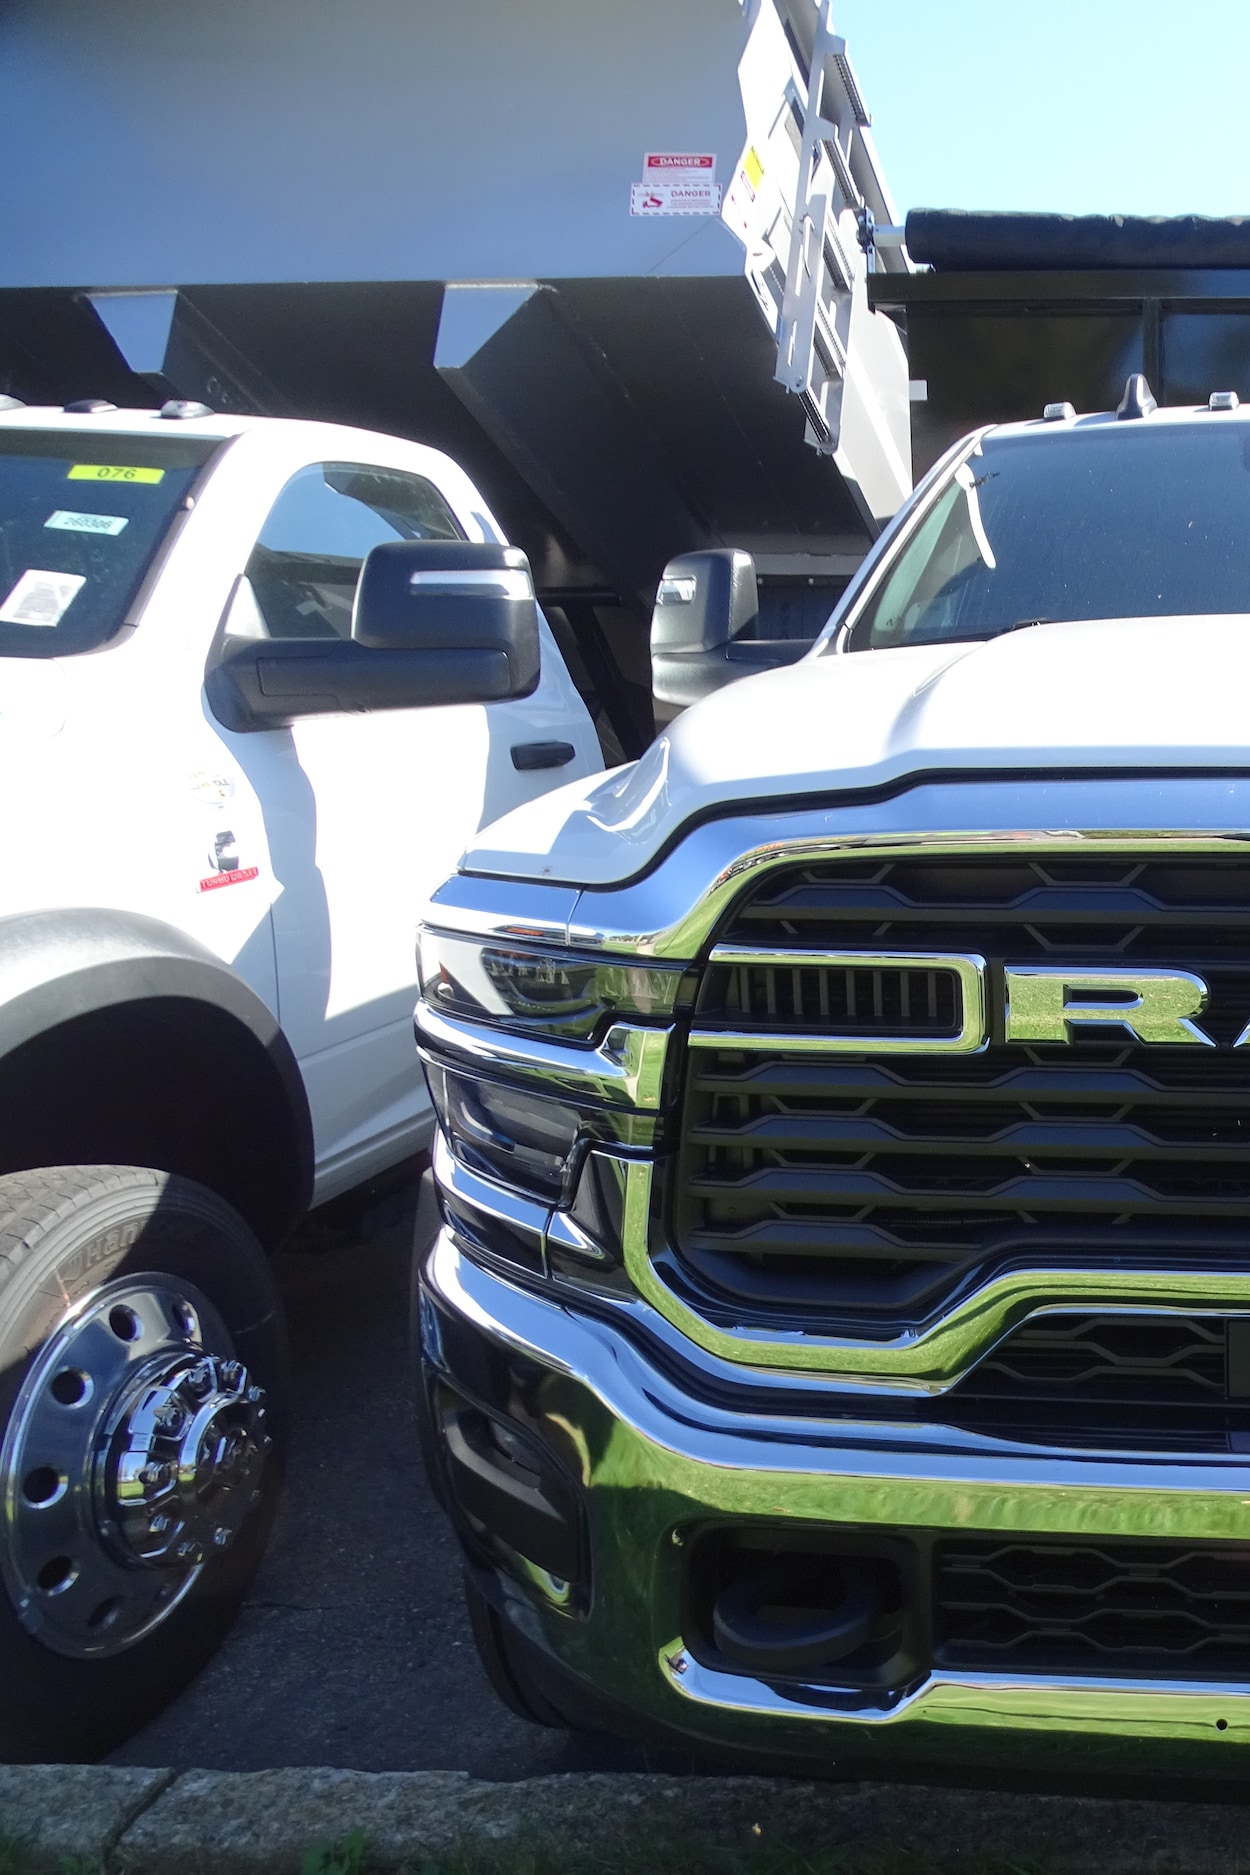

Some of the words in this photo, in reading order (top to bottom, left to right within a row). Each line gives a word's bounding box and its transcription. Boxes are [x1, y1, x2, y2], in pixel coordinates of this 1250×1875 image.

[660, 156, 701, 166] DANGER
[671, 190, 711, 198] DANGER
[97, 466, 137, 480] 076
